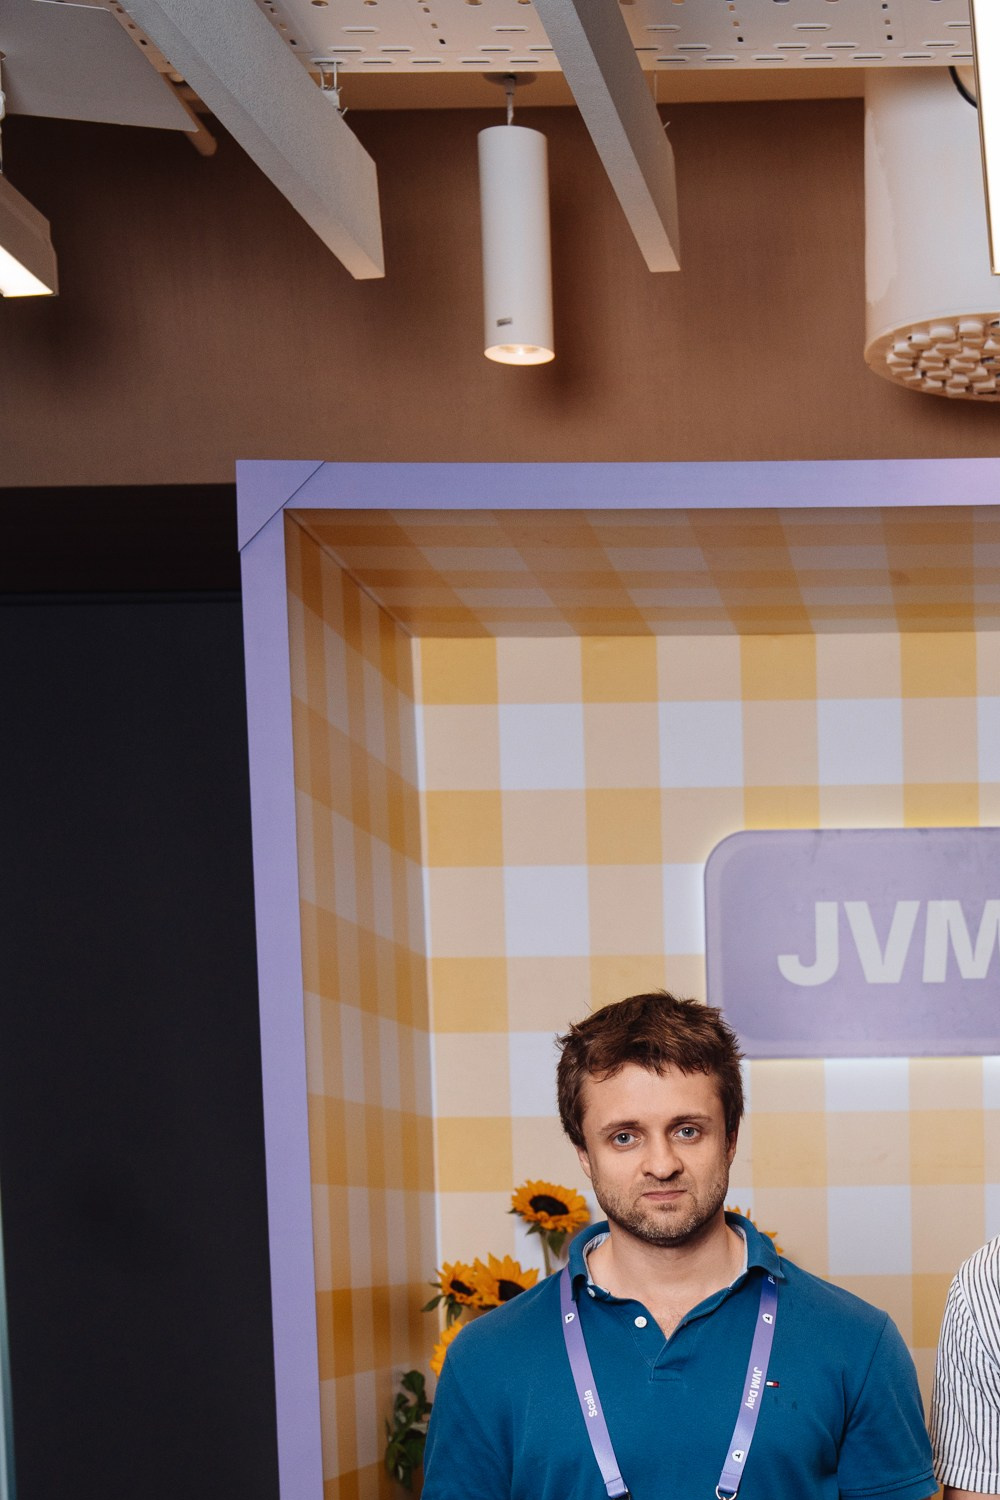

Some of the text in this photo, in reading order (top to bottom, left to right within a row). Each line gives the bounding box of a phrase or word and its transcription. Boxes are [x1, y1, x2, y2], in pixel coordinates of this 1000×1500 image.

[584, 1390, 597, 1418] Scala
[744, 1366, 763, 1410] JVM Day
